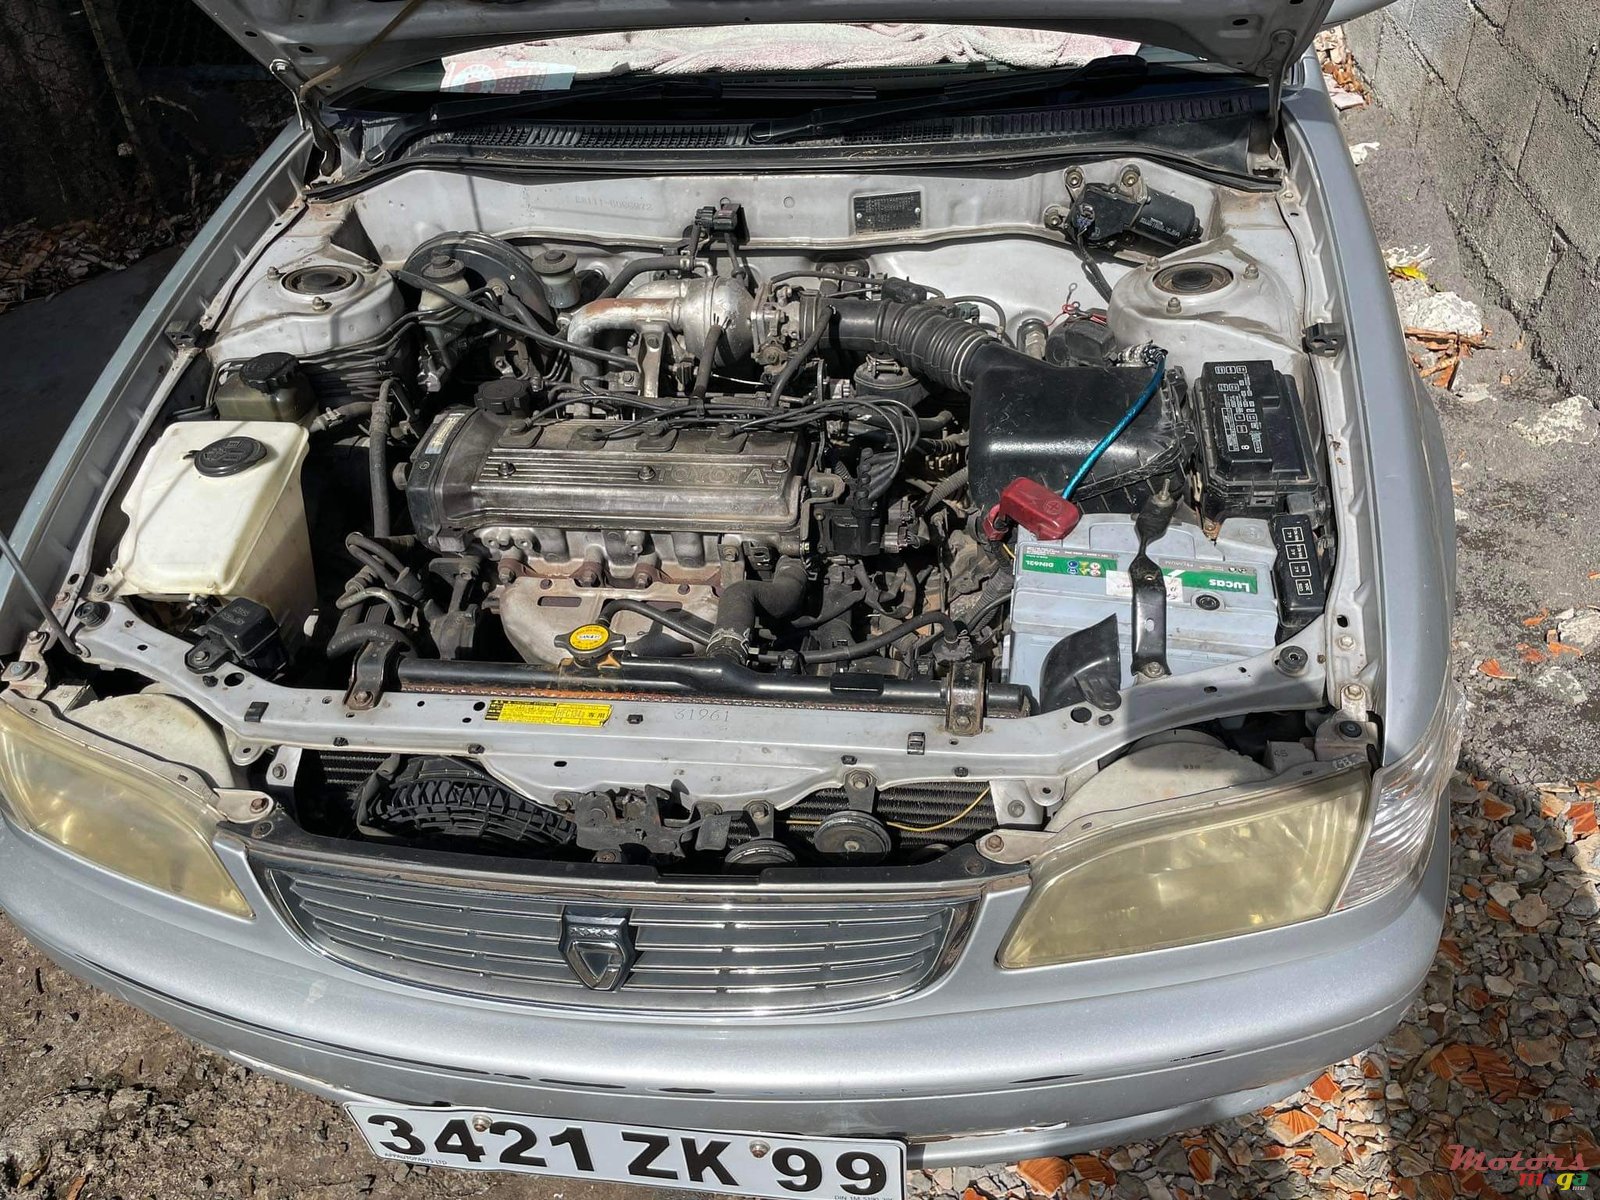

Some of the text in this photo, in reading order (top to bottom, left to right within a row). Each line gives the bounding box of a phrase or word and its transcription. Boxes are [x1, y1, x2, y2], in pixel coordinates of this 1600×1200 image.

[655, 466, 765, 485] TOYOTA
[1208, 579, 1250, 593] Lucas
[367, 1113, 888, 1196] 3421 ZK 99
